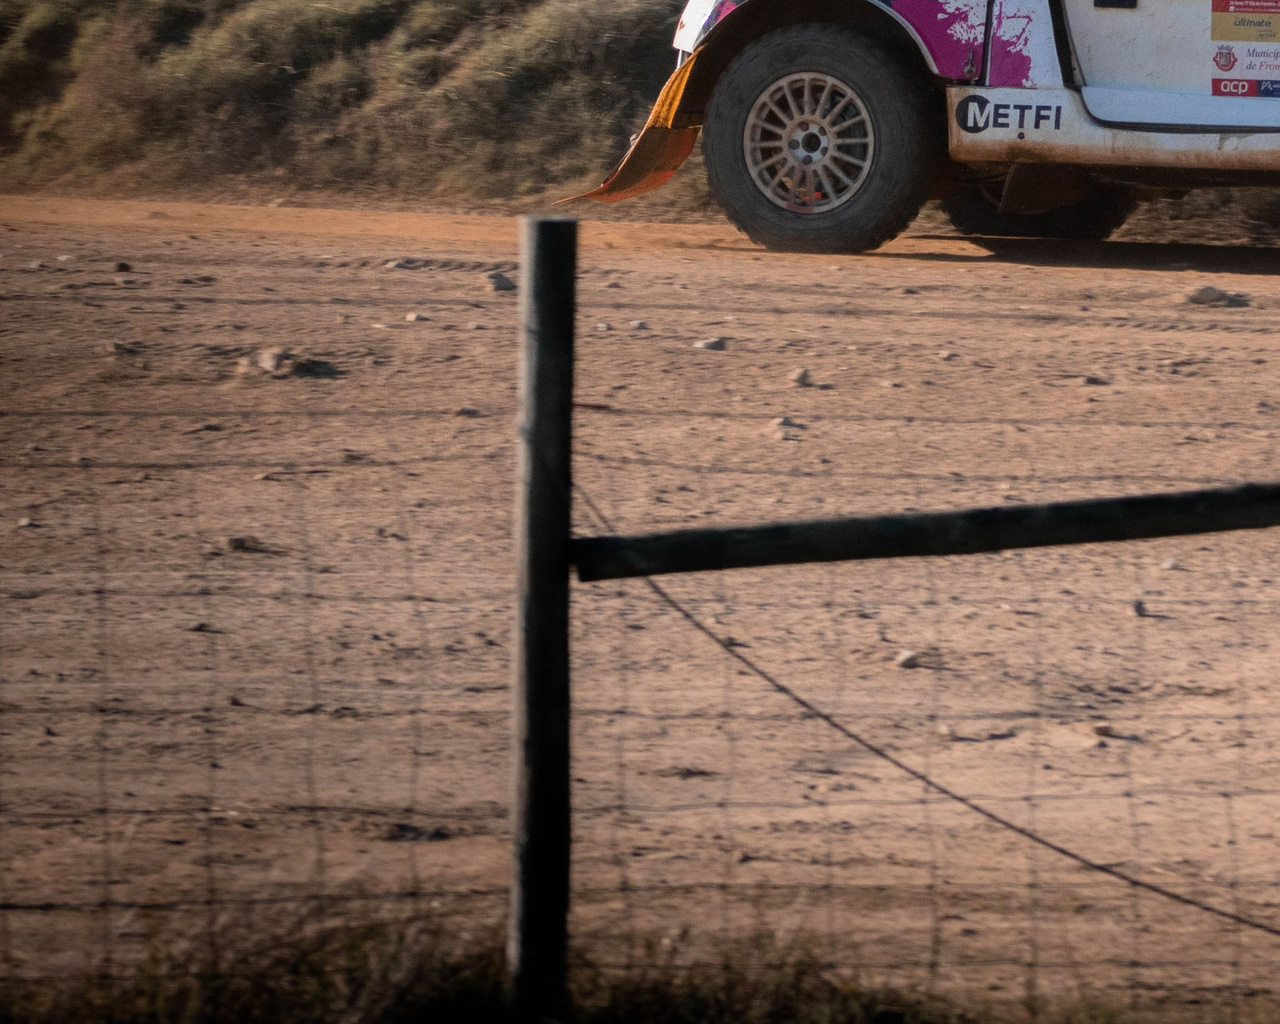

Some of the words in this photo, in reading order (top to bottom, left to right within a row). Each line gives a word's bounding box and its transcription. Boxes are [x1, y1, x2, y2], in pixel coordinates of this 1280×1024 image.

[1246, 62, 1256, 70] de
[1220, 81, 1248, 94] acp
[966, 102, 1062, 130] METFI
